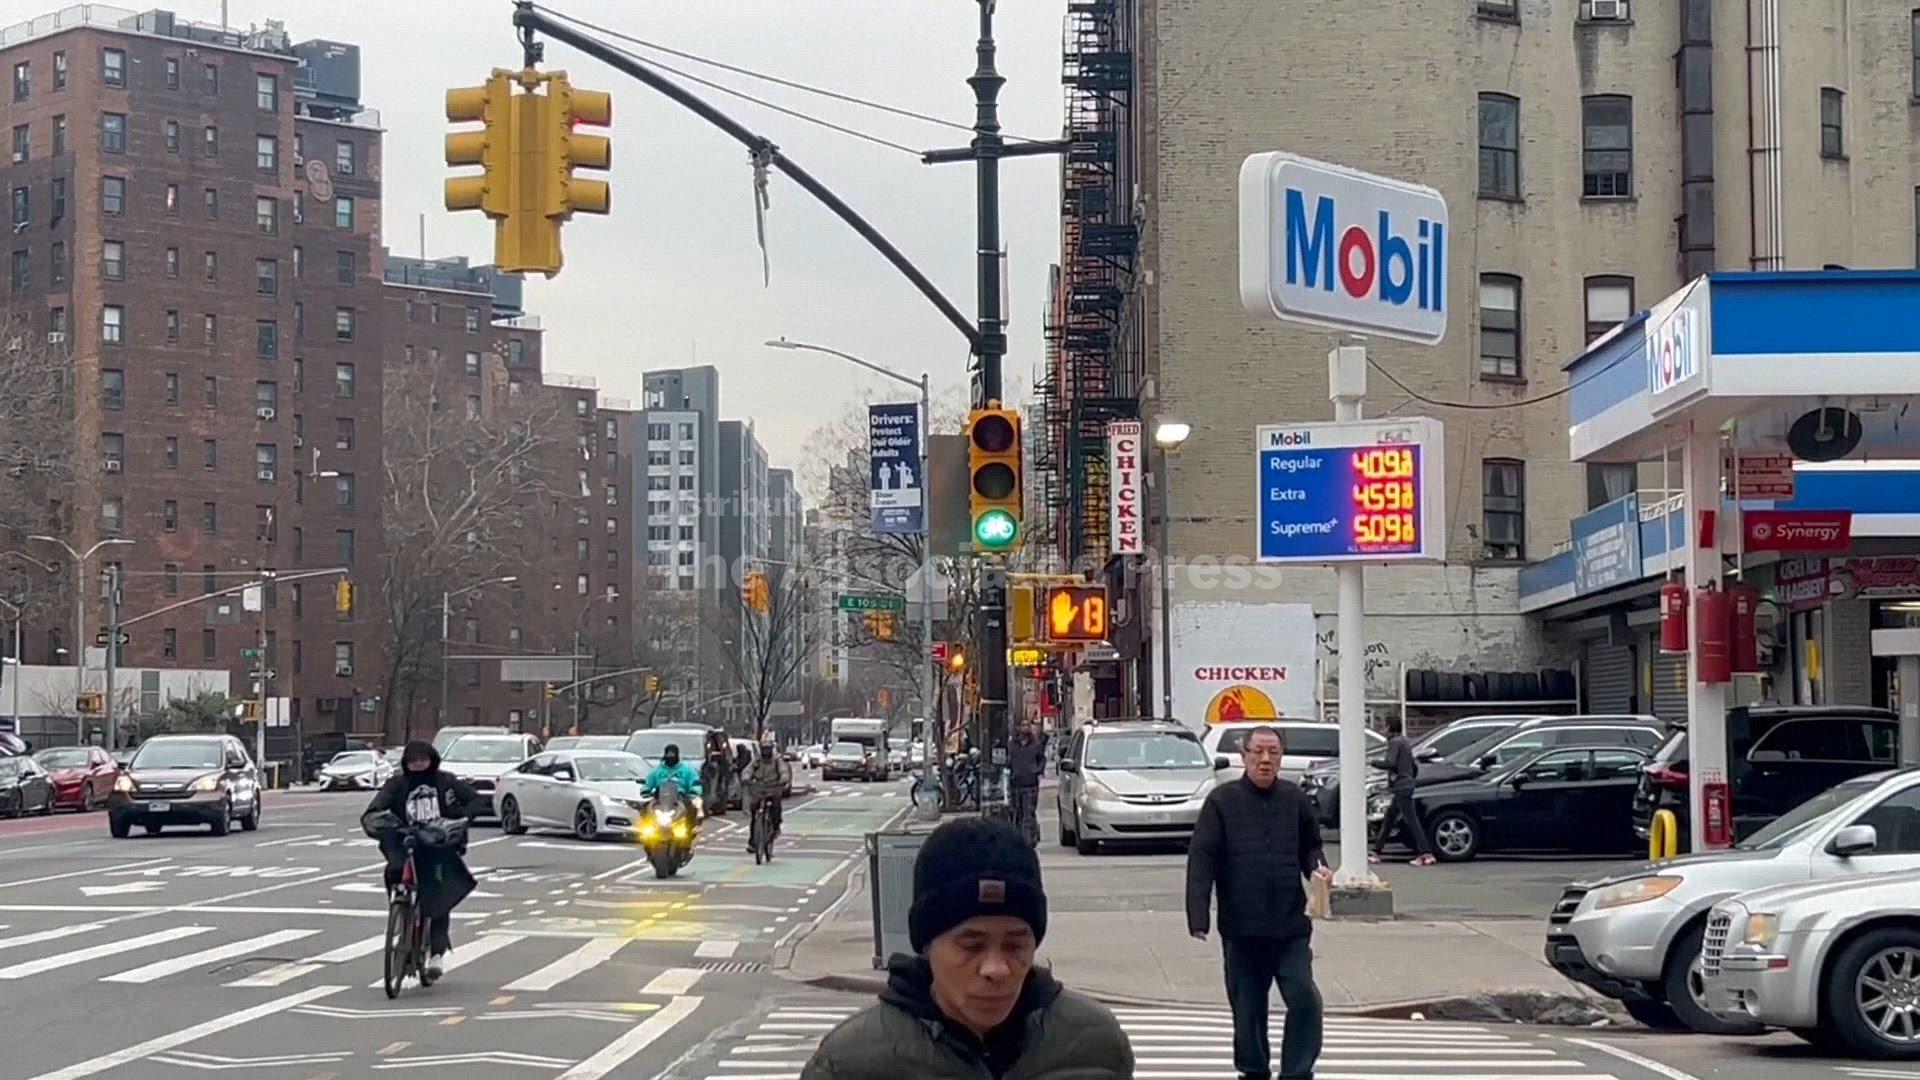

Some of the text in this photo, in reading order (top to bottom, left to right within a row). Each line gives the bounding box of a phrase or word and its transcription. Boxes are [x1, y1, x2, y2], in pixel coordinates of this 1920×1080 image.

[1285, 189, 1444, 313] Mobil
[1650, 310, 1692, 393] Mobil
[871, 414, 914, 425] Drivers:
[871, 427, 902, 436] Protect
[1112, 424, 1140, 436] FRIED
[871, 437, 912, 447] Our Older
[1270, 431, 1311, 446] Mobil
[871, 449, 899, 458] Adults
[1270, 455, 1323, 473] Regular
[1116, 440, 1138, 551] CHICKEN
[1270, 487, 1306, 501] Extra
[1270, 516, 1339, 537] Supreme+
[1776, 524, 1840, 541] Synergy
[847, 598, 855, 607] E
[1194, 666, 1287, 681] CHICKEN
